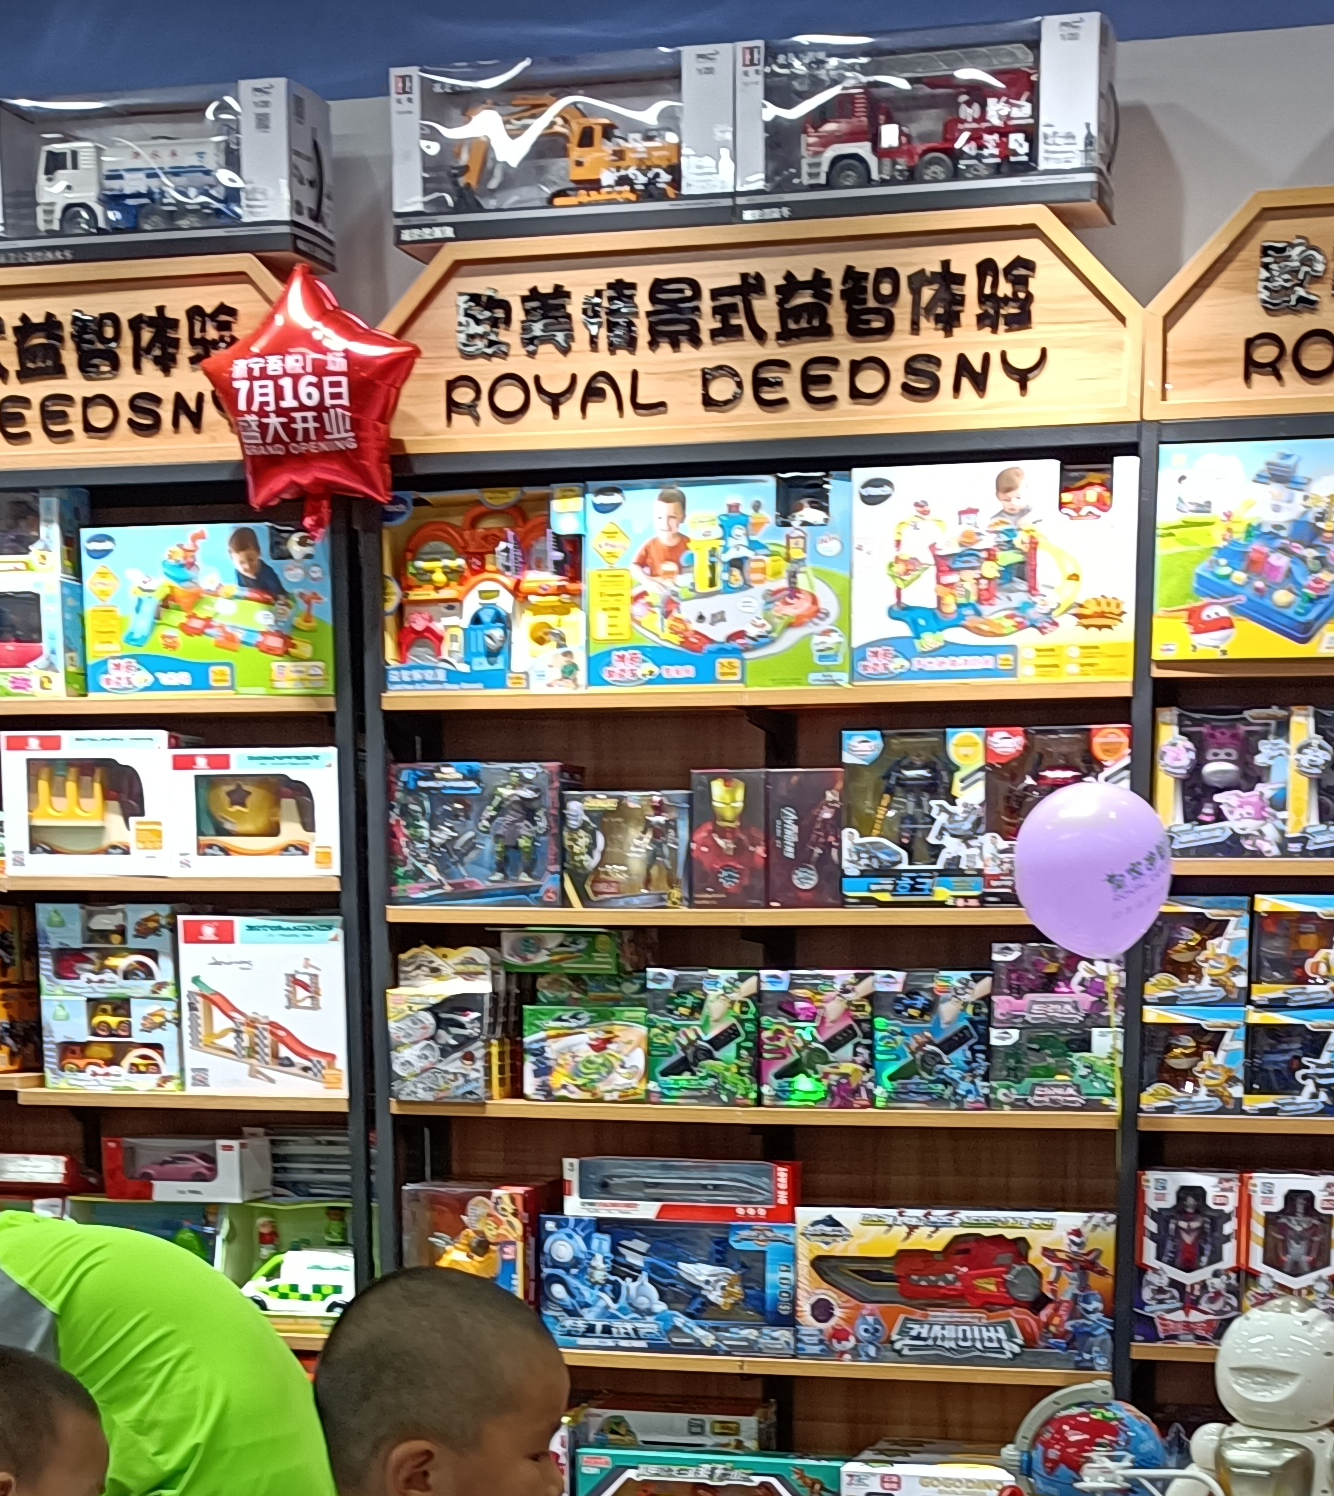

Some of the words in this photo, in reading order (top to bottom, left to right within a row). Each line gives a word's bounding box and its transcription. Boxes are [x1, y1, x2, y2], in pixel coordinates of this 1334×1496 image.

[454, 254, 1038, 361] 欧美情景式益智体验
[232, 375, 351, 411] 7月16日
[445, 369, 668, 428] ROYAL
[700, 346, 1048, 414] DEEDSNY
